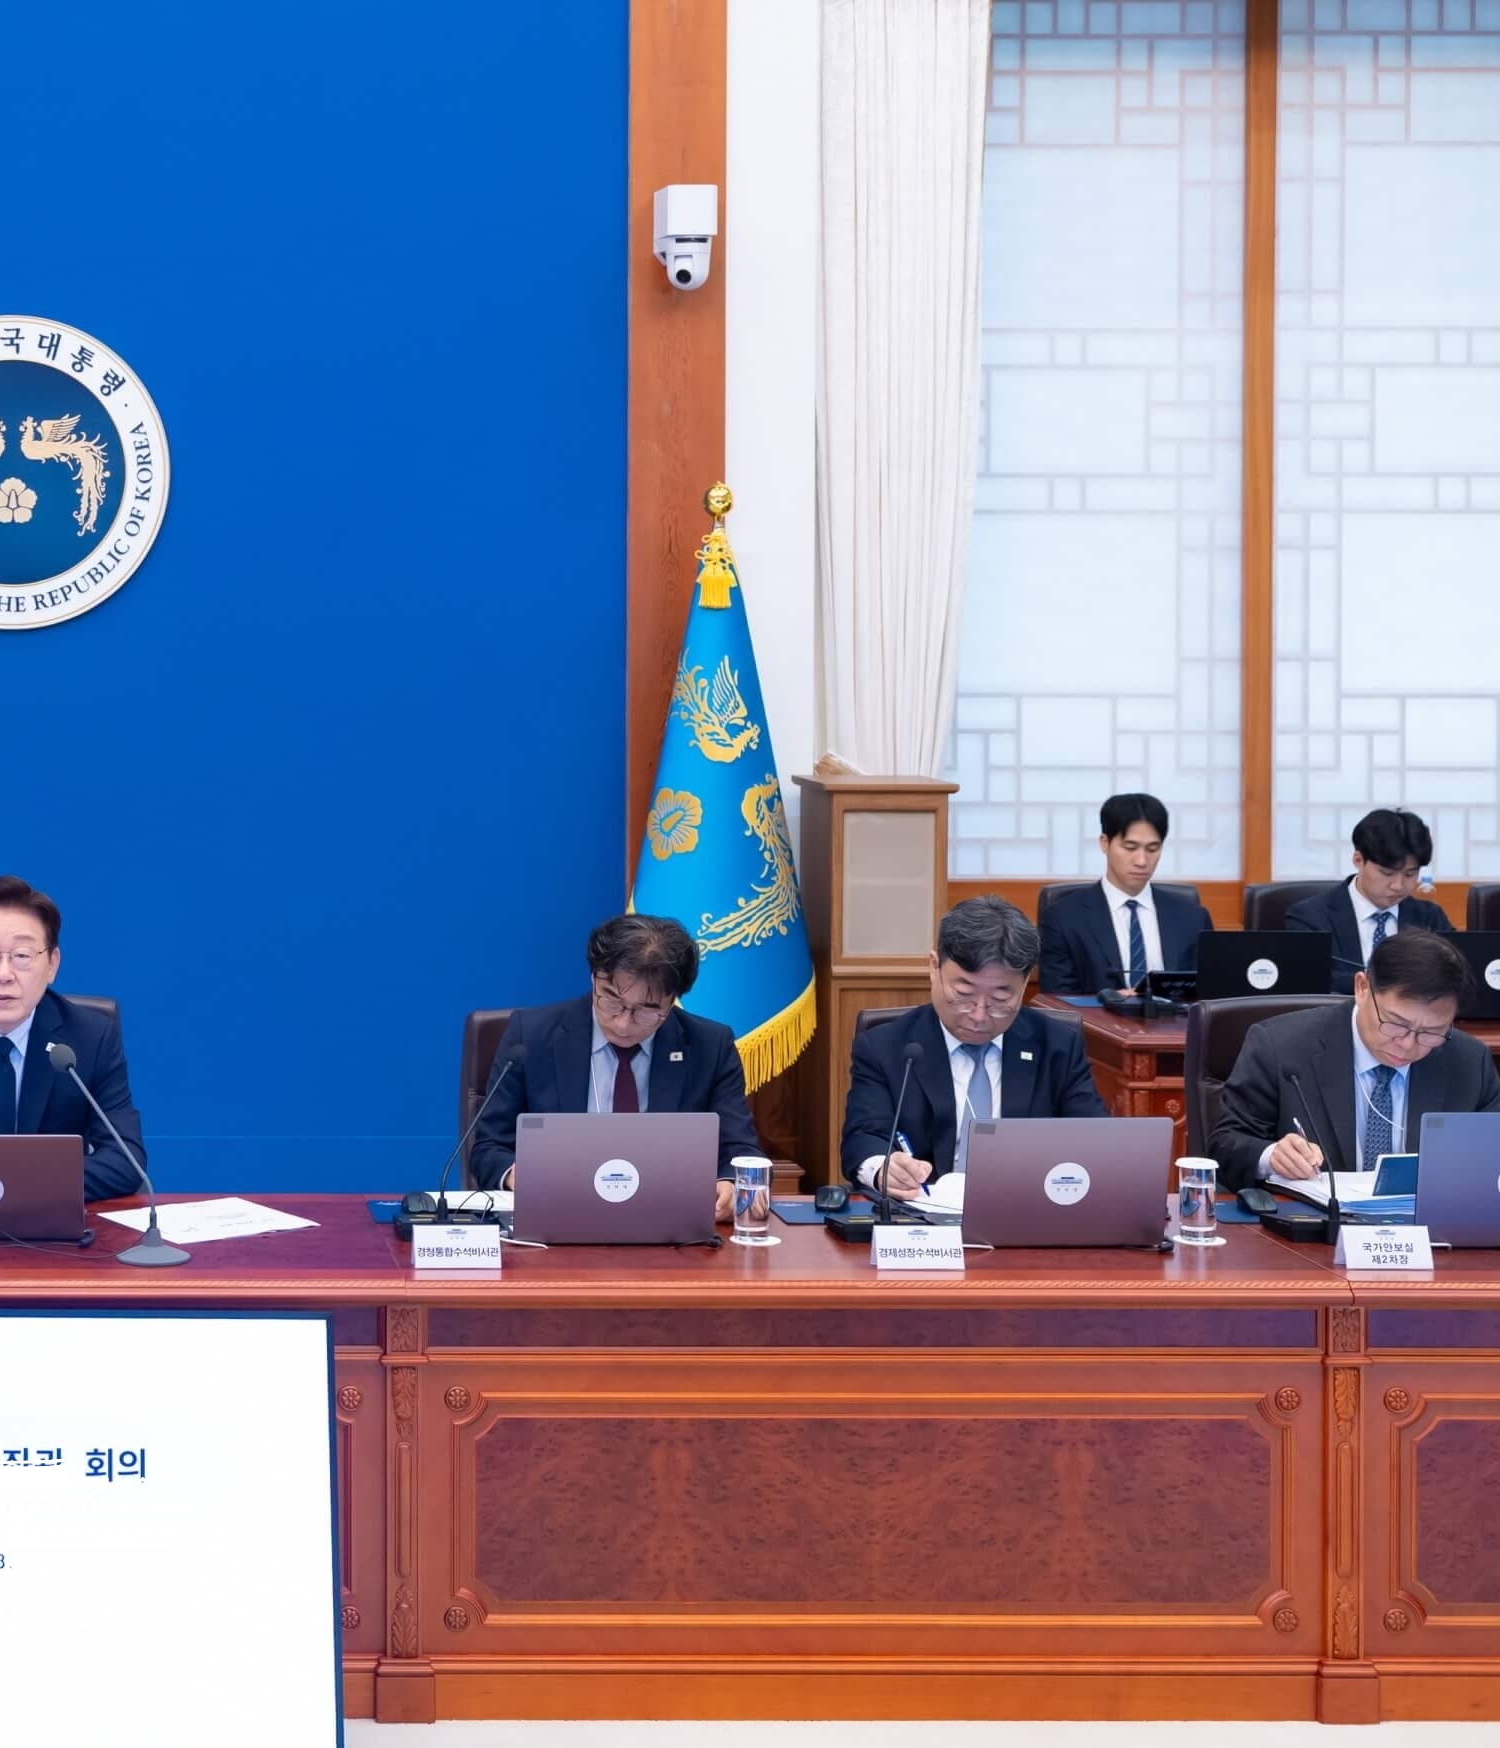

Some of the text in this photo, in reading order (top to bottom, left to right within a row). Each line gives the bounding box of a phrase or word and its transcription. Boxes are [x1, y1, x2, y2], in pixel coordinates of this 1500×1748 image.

[129, 420, 153, 503] KOREA
[123, 506, 145, 538] OF
[33, 538, 131, 611] REPUBLIC
[879, 1247, 962, 1258] 경제성장수석비서관
[1362, 1242, 1414, 1253] 국가안보실
[1372, 1255, 1408, 1265] 제2차장
[85, 1447, 146, 1482] 회의
